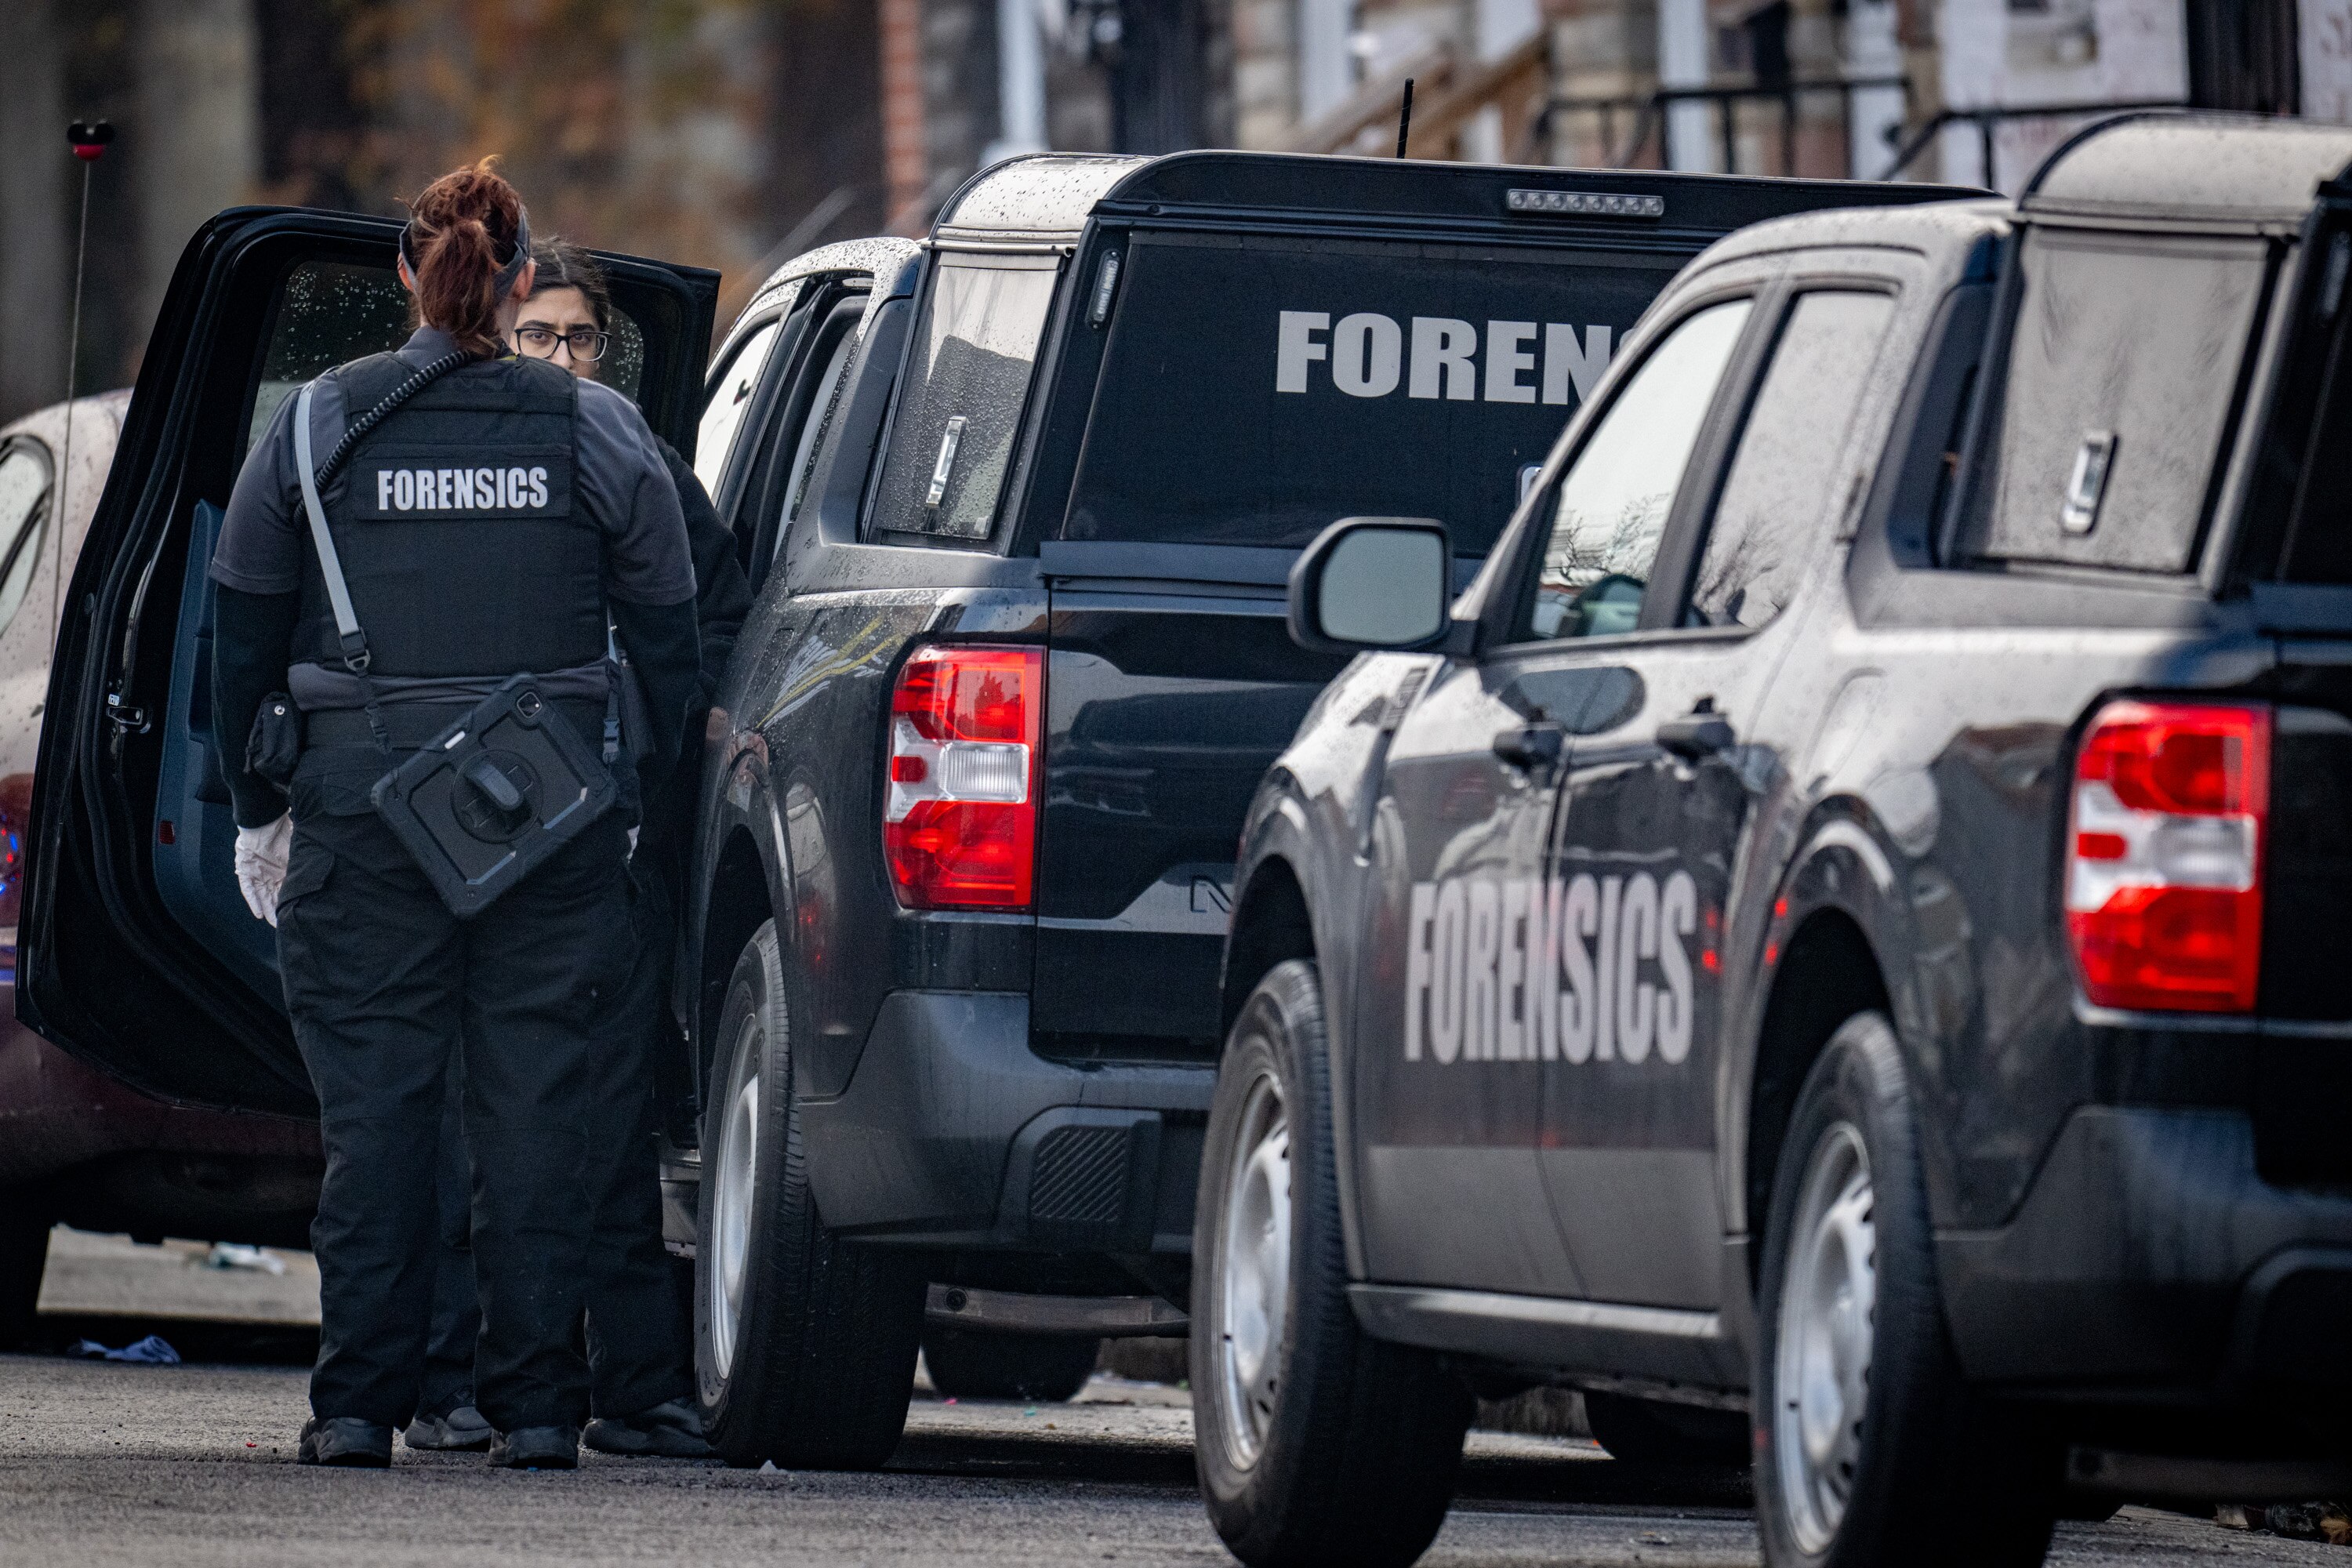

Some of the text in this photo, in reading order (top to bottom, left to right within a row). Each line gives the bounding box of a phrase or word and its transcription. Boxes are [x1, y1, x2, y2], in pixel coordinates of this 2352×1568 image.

[1276, 310, 1637, 405] FOREN
[378, 466, 548, 510] FORENSICS
[1404, 869, 1697, 1065] FORENSICS
